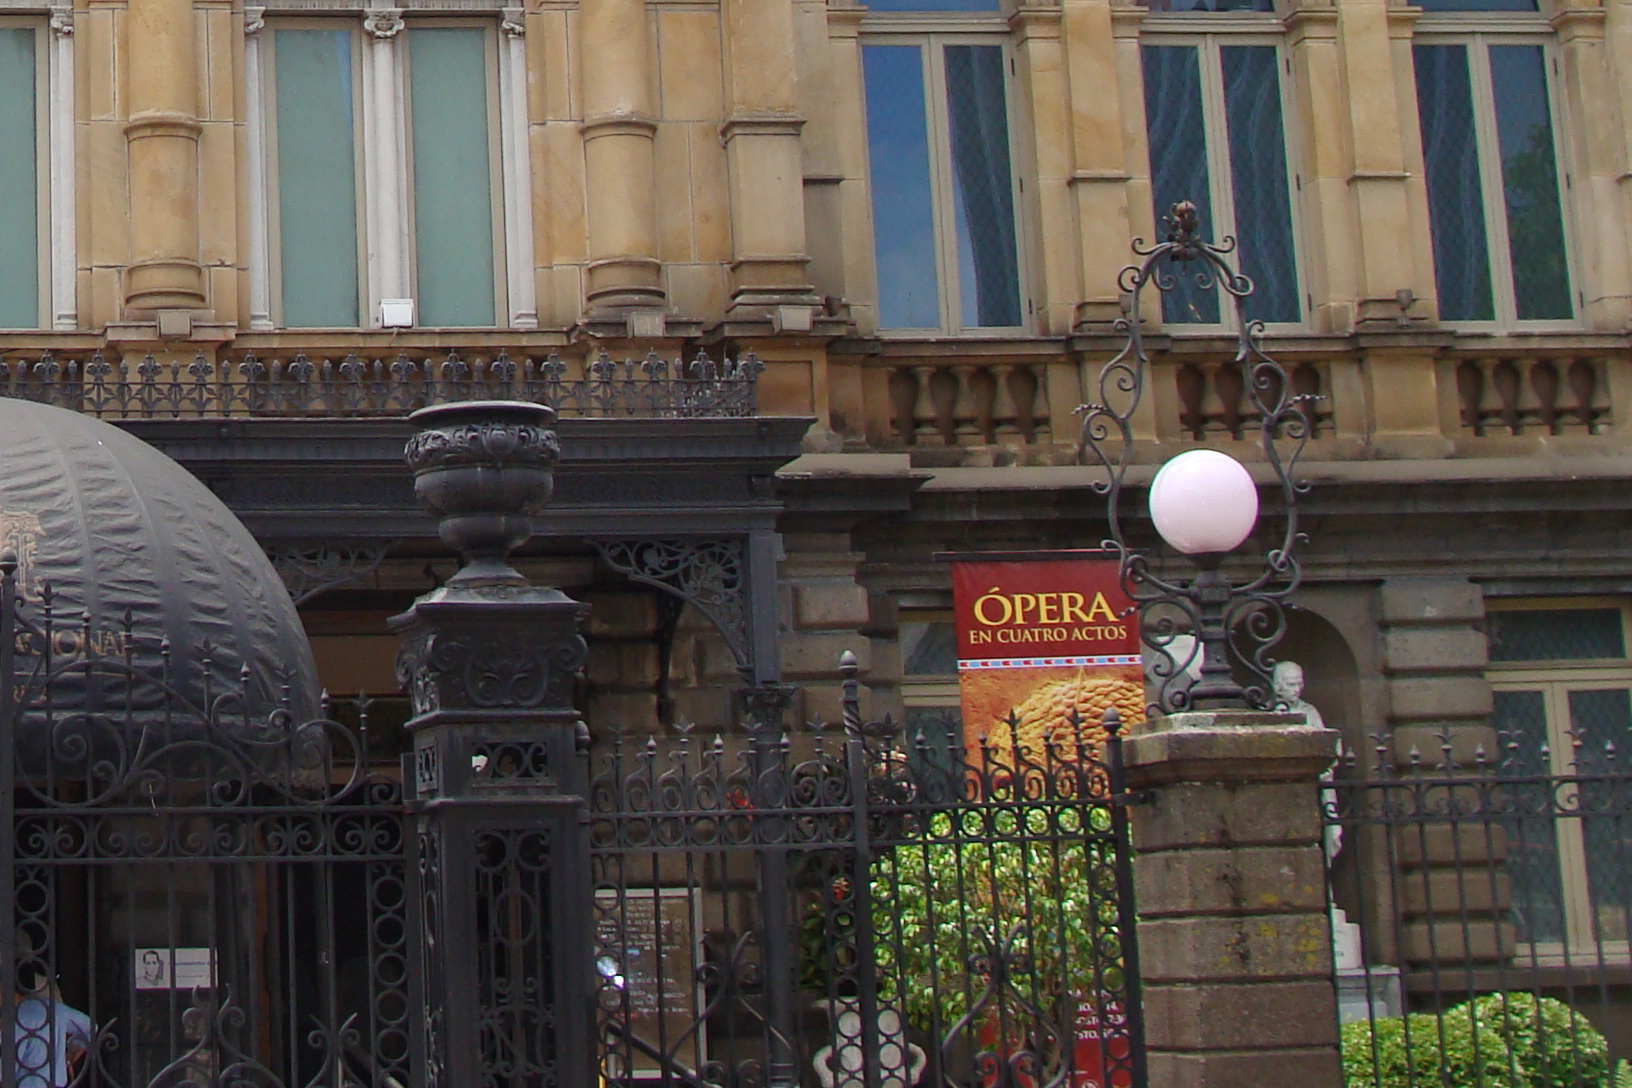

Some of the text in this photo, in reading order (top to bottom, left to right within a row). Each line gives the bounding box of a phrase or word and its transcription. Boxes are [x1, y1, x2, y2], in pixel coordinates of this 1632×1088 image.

[973, 586, 1120, 626] ÓPERA
[969, 625, 1127, 644] EN CUATRO ACTOS
